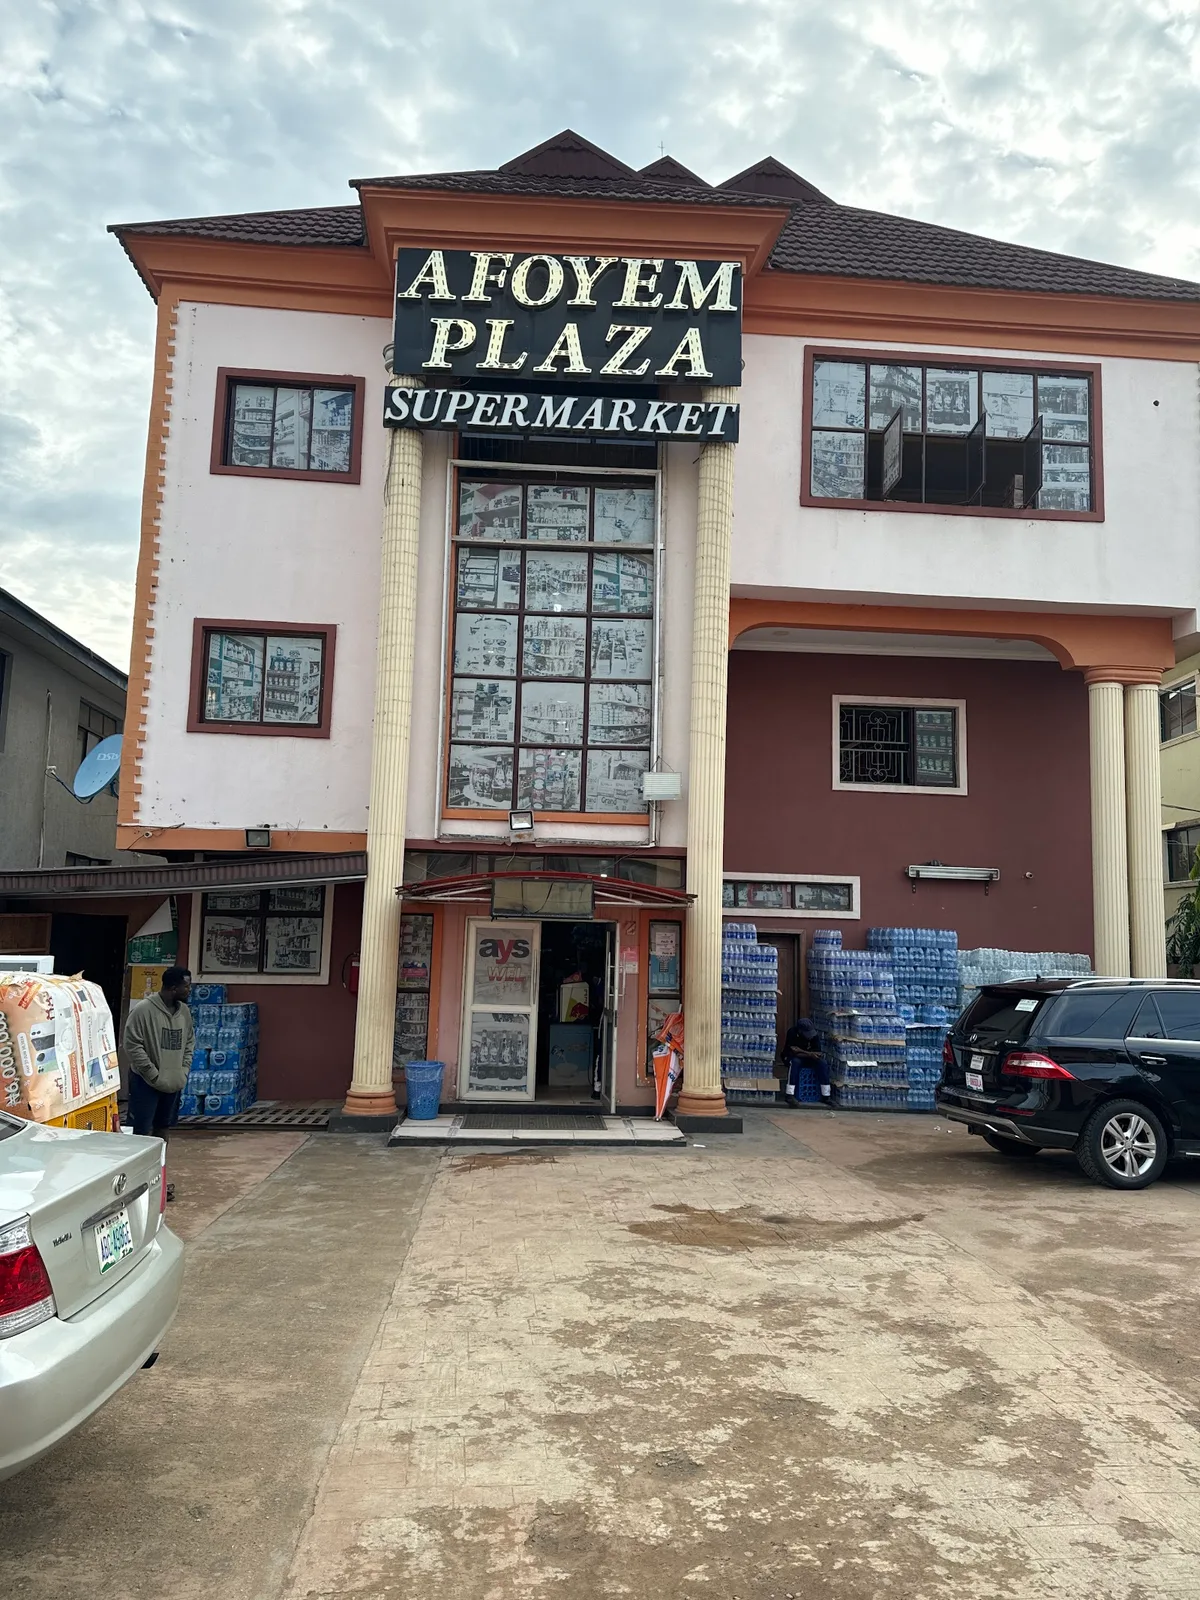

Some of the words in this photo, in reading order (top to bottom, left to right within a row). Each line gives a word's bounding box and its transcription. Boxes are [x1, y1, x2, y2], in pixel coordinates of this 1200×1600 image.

[421, 317, 713, 378] PLAZA
[384, 387, 738, 436] SUPERMARKET
[479, 938, 530, 965] ays
